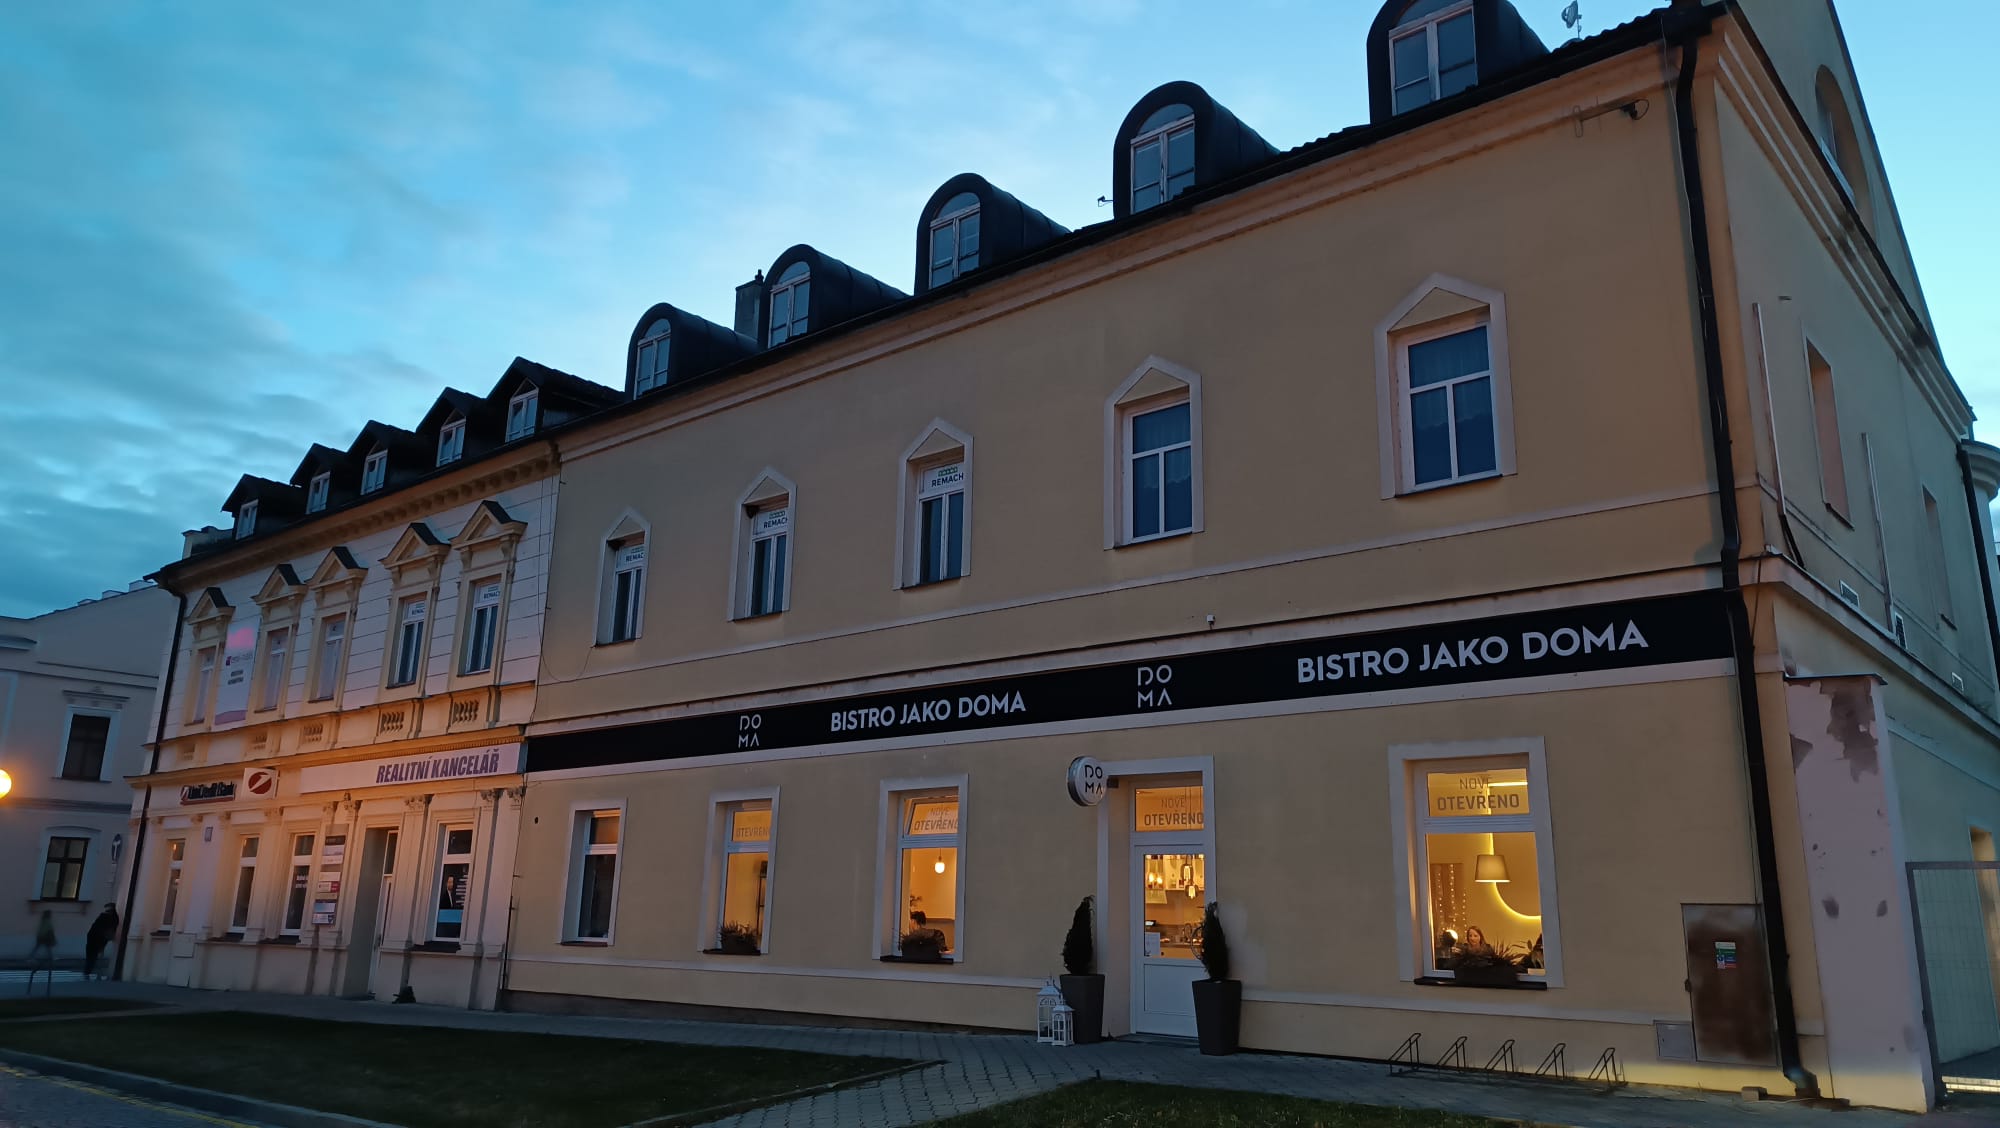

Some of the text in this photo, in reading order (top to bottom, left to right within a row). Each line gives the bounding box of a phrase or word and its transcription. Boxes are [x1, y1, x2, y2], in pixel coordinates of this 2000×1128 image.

[931, 471, 964, 488] REMACH
[626, 552, 645, 562] REMAC
[1297, 619, 1649, 684] BISTRO JAKO DOMA
[1137, 664, 1173, 686] DO
[1137, 687, 1173, 709] MA
[830, 690, 1027, 732] BISTRO JAKO DOMA
[739, 713, 762, 731] DO
[738, 732, 760, 748] MA
[376, 748, 500, 784] REALITNÍ KANCELÁŘ
[1084, 764, 1103, 779] DO
[1085, 781, 1103, 795] MA
[1437, 791, 1520, 811] OTEVŘENO
[1144, 809, 1204, 826] OTEVŘENO
